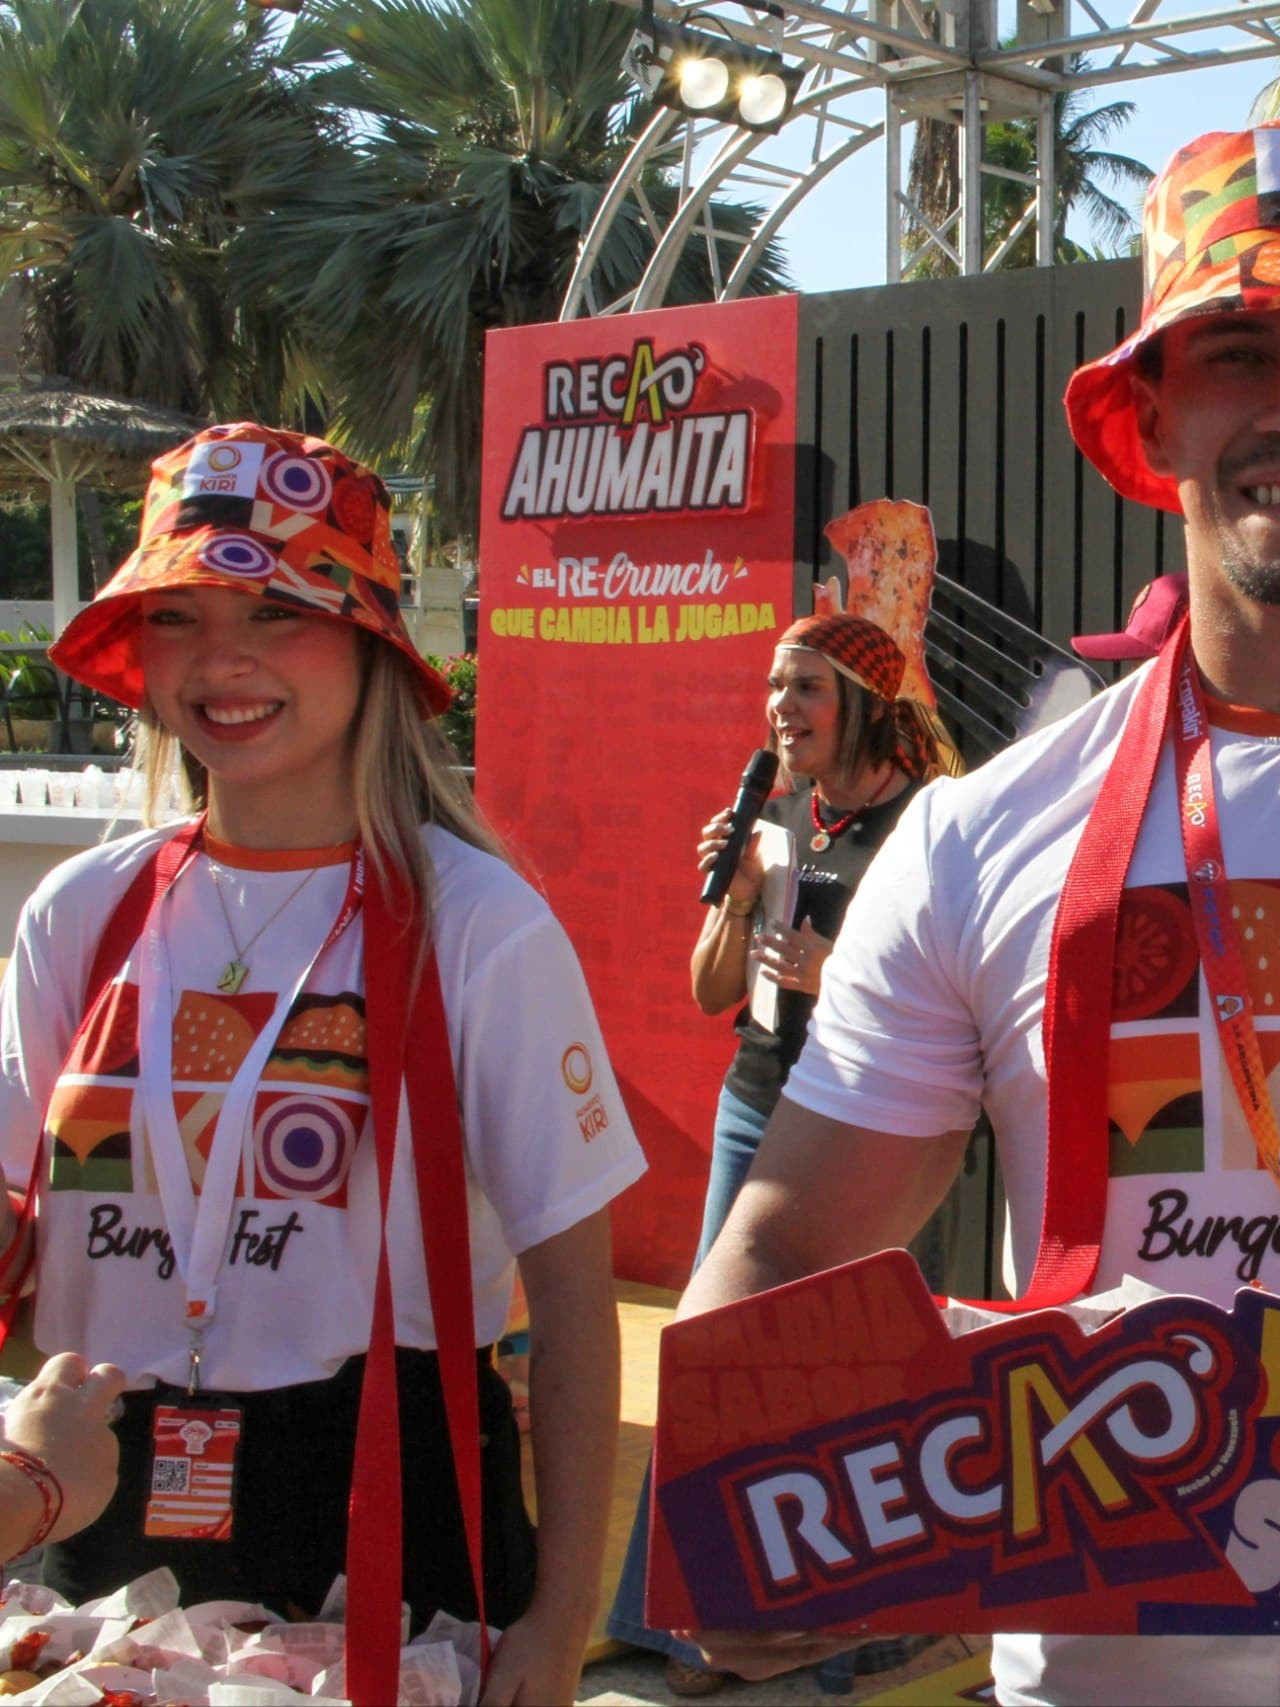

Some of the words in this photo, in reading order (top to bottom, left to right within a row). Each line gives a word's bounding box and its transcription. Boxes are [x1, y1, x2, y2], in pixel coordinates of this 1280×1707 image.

[503, 412, 749, 516] AHUMAITA
[200, 479, 237, 492] KIRI
[531, 570, 556, 589] EL
[490, 608, 535, 639] QUE
[539, 606, 632, 644] CAMBIA
[637, 605, 671, 644] LA
[675, 602, 776, 641] JUGADA
[578, 1104, 609, 1144] KIRI
[87, 1203, 176, 1280] Burg
[229, 1210, 304, 1272] Fest
